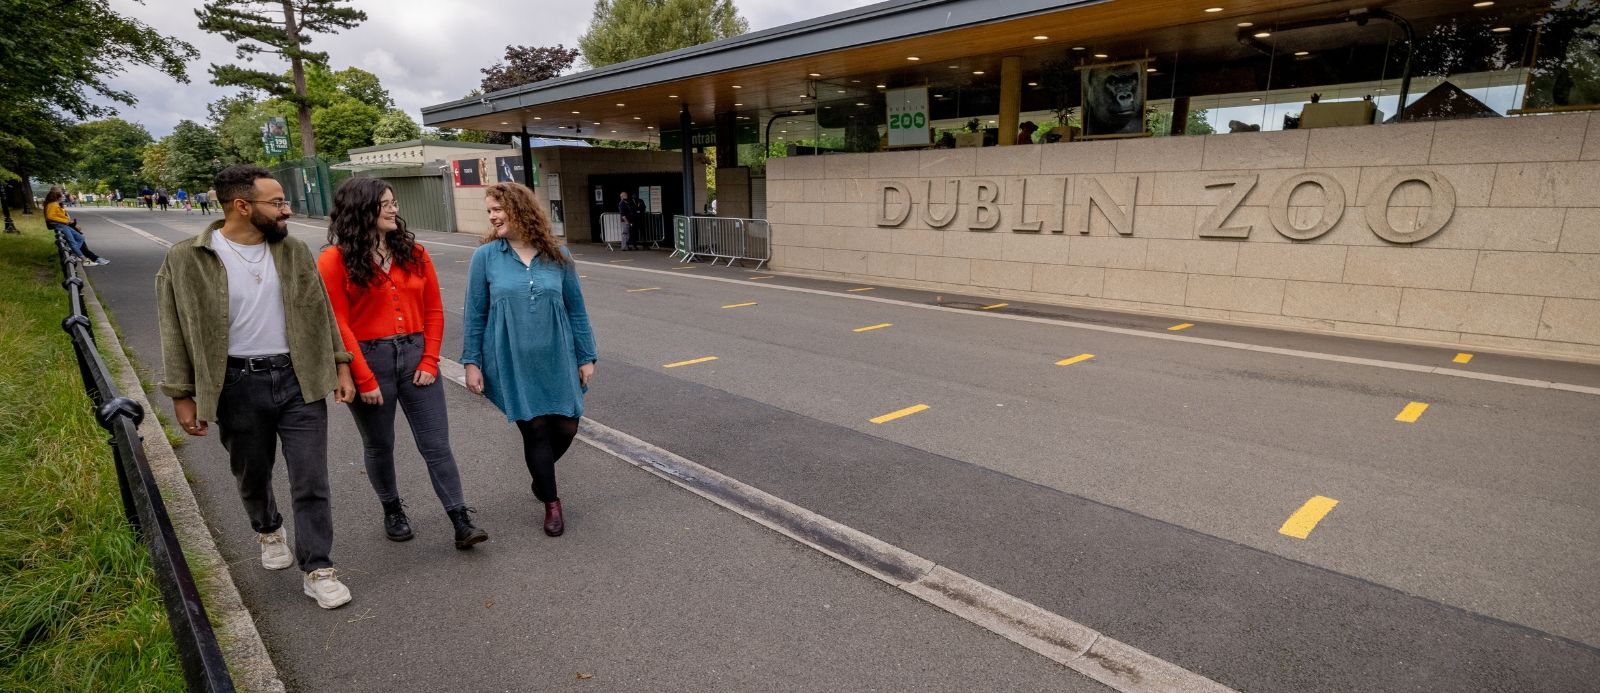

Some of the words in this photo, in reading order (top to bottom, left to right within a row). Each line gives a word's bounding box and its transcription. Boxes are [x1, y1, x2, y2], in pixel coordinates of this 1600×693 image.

[890, 112, 926, 129] ZOO
[691, 132, 717, 145] ntran
[876, 176, 1139, 236] DUBLIN
[1198, 169, 1457, 244] ZOO
